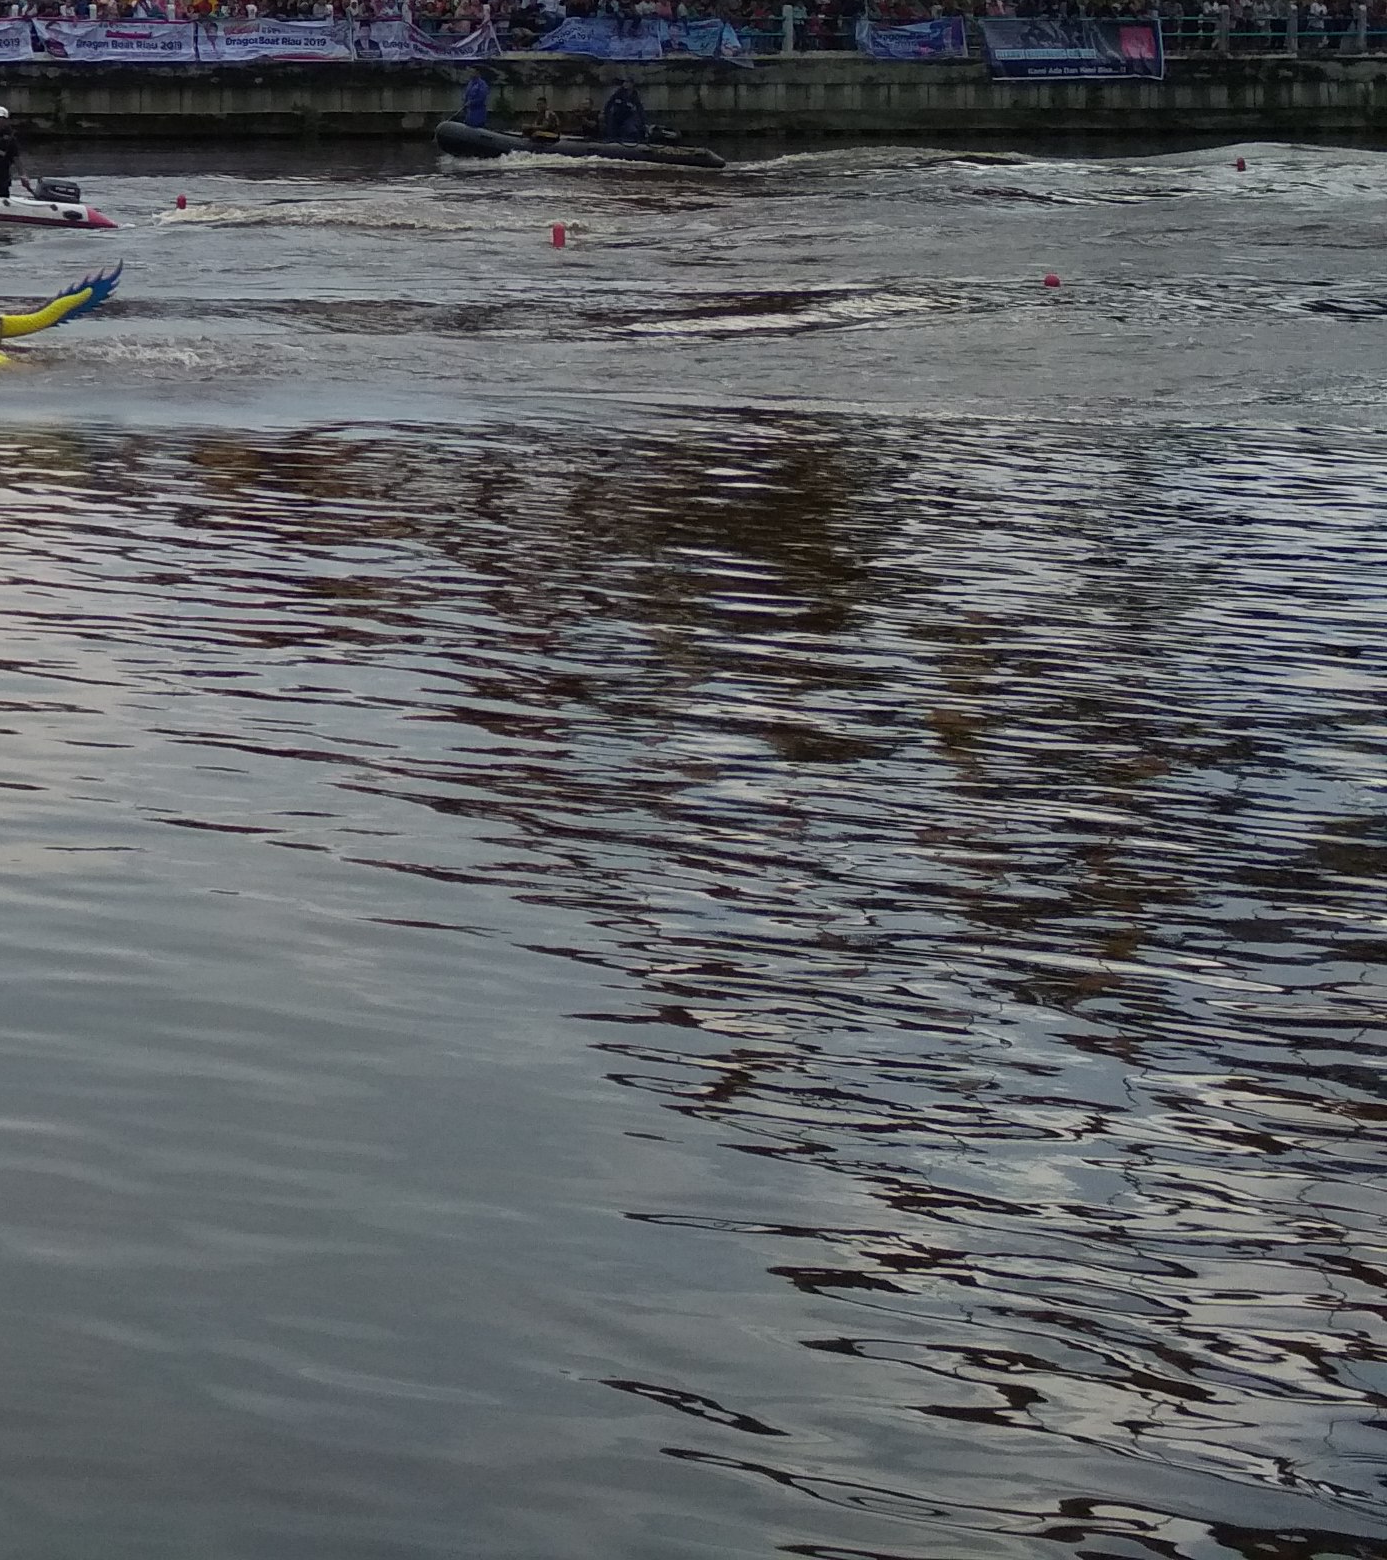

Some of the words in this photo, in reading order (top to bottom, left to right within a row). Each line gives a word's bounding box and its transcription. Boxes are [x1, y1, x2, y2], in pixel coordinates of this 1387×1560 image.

[76, 39, 108, 50] Dragon
[111, 40, 134, 49] Boat
[160, 41, 182, 50] 2019
[259, 36, 279, 45] Boat
[281, 37, 302, 46] Riau
[303, 38, 326, 47] 2019
